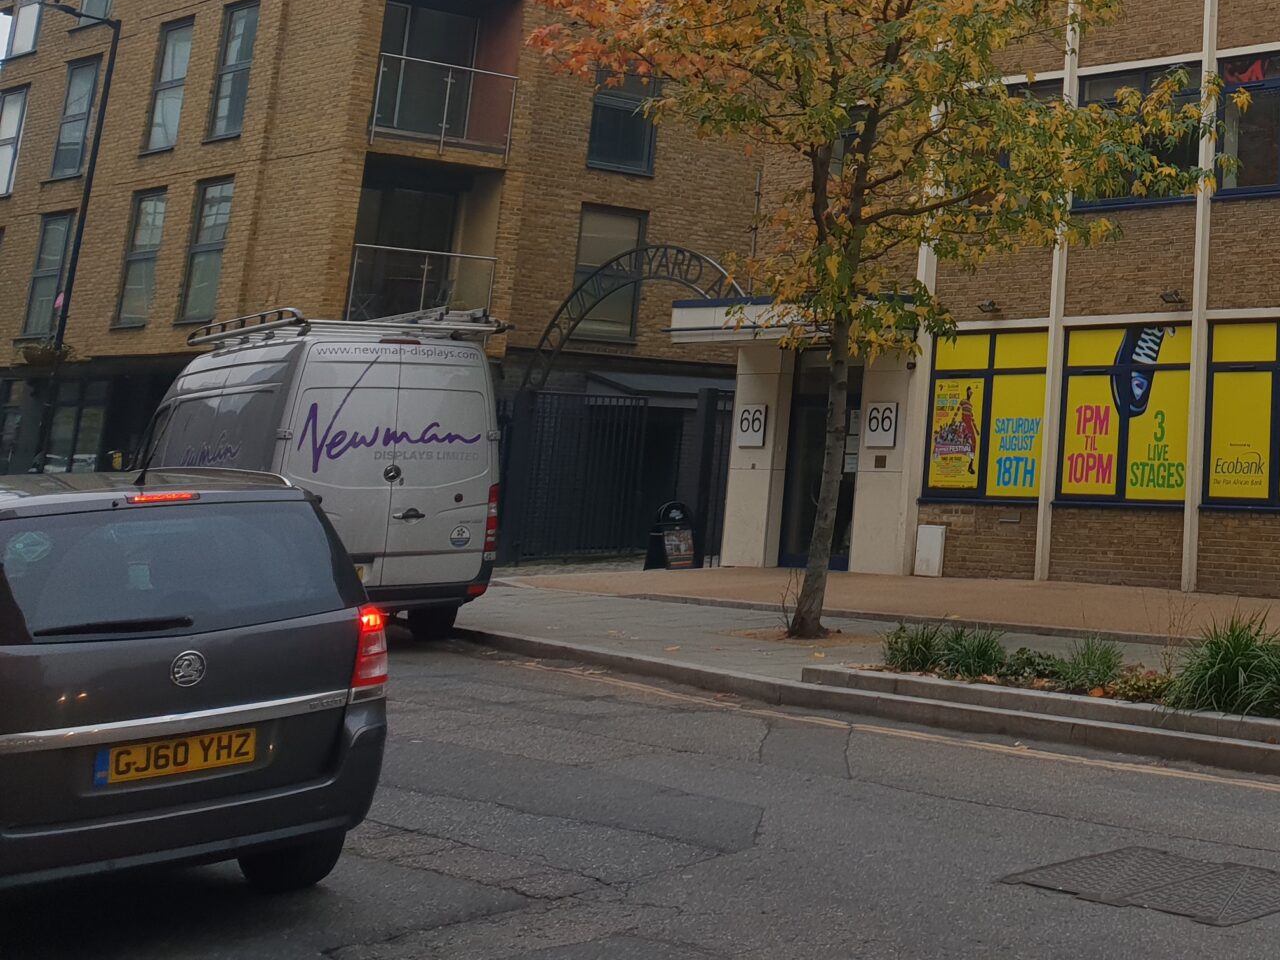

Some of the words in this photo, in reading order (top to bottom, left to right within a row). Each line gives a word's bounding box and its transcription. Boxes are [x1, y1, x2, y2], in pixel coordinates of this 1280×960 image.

[645, 246, 703, 285] YARD
[316, 343, 480, 361] www.newman-displays.com
[297, 355, 482, 474] Newman
[740, 409, 762, 432] 66
[868, 407, 893, 432] 66
[995, 417, 1041, 434] SATURDAY
[1076, 405, 1111, 436] 1PM
[1153, 410, 1166, 442] 3
[374, 450, 434, 461] DISPLAYS
[436, 451, 480, 461] LIMITED
[999, 435, 1034, 451] AUGUST
[1085, 435, 1098, 451] TIL
[1147, 444, 1168, 461] LIVE
[996, 456, 1036, 488] 18TH
[1067, 453, 1114, 484] 10PM
[1130, 462, 1185, 488] STAGES
[1214, 451, 1265, 475] Ecobank
[114, 740, 190, 775] GJ60
[200, 733, 250, 763] YHZ
